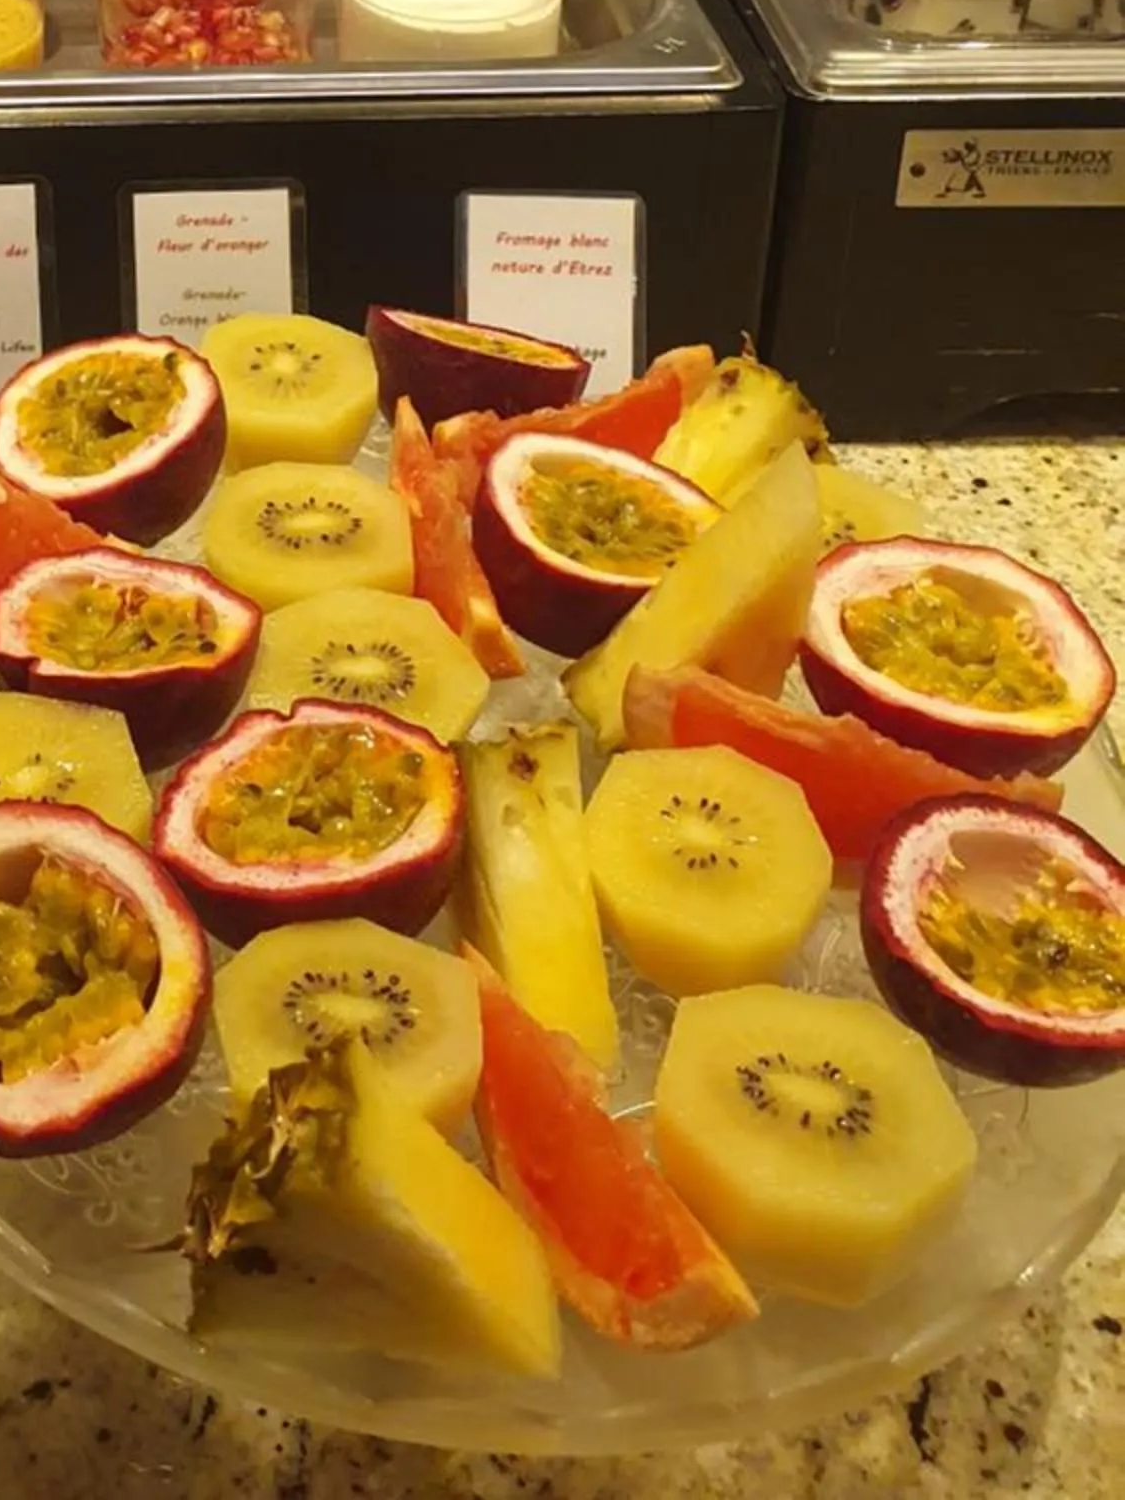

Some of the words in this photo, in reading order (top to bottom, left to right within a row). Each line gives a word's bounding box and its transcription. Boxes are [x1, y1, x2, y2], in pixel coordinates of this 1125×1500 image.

[985, 150, 1113, 165] STELLINOX
[176, 214, 233, 227] Grenade
[158, 240, 193, 253] Fleur
[496, 231, 561, 250] Fromage
[570, 233, 610, 248] blanc
[491, 261, 545, 275] nature
[159, 312, 208, 329] Orange
